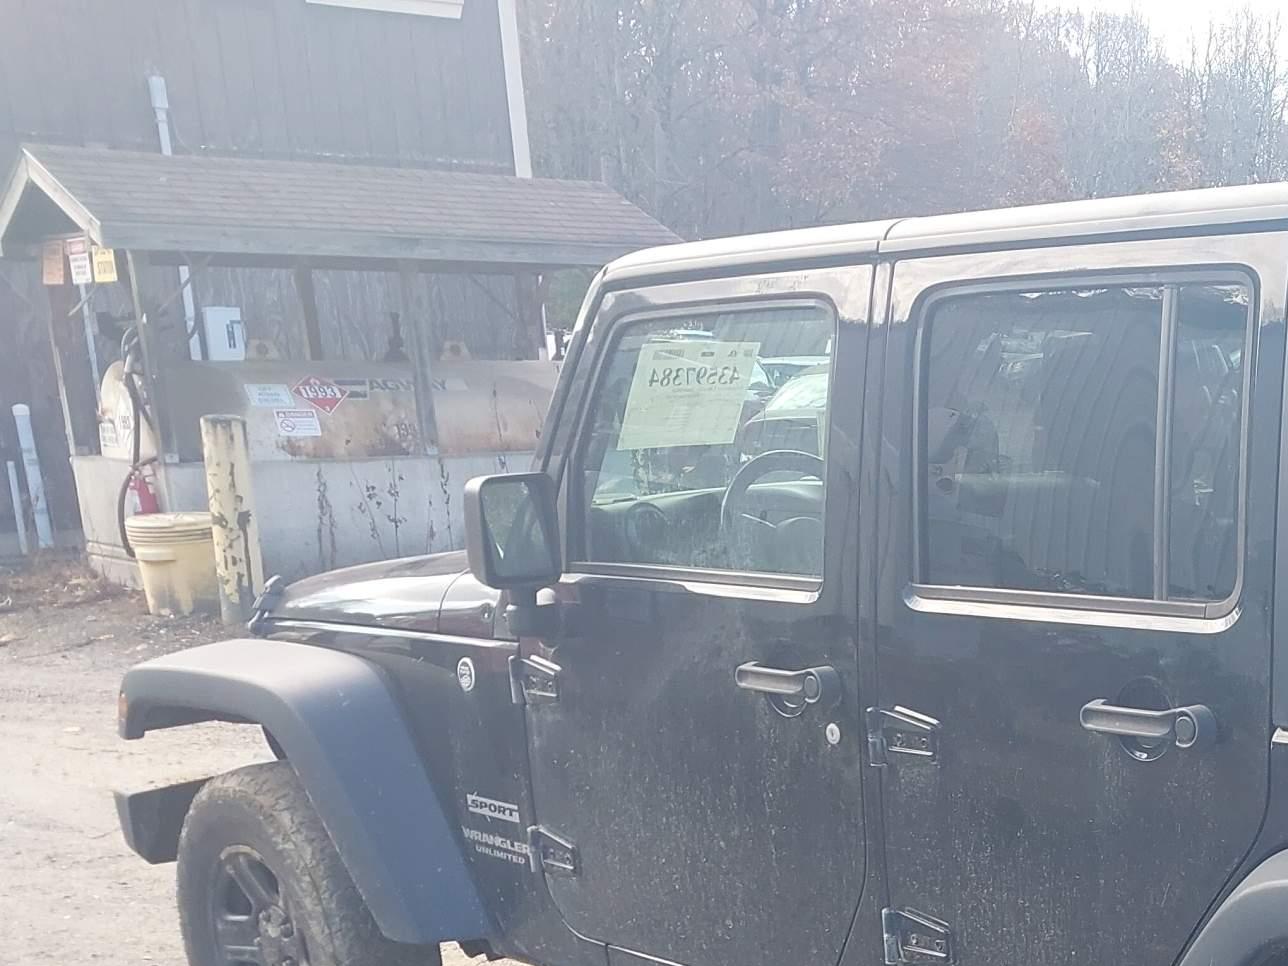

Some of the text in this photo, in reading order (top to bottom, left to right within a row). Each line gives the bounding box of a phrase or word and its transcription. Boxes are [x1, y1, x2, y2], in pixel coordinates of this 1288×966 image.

[302, 386, 338, 399] 1993
[469, 799, 518, 817] SPORT
[461, 825, 530, 854] WRANGLER
[475, 844, 526, 865] UNLIMITED
